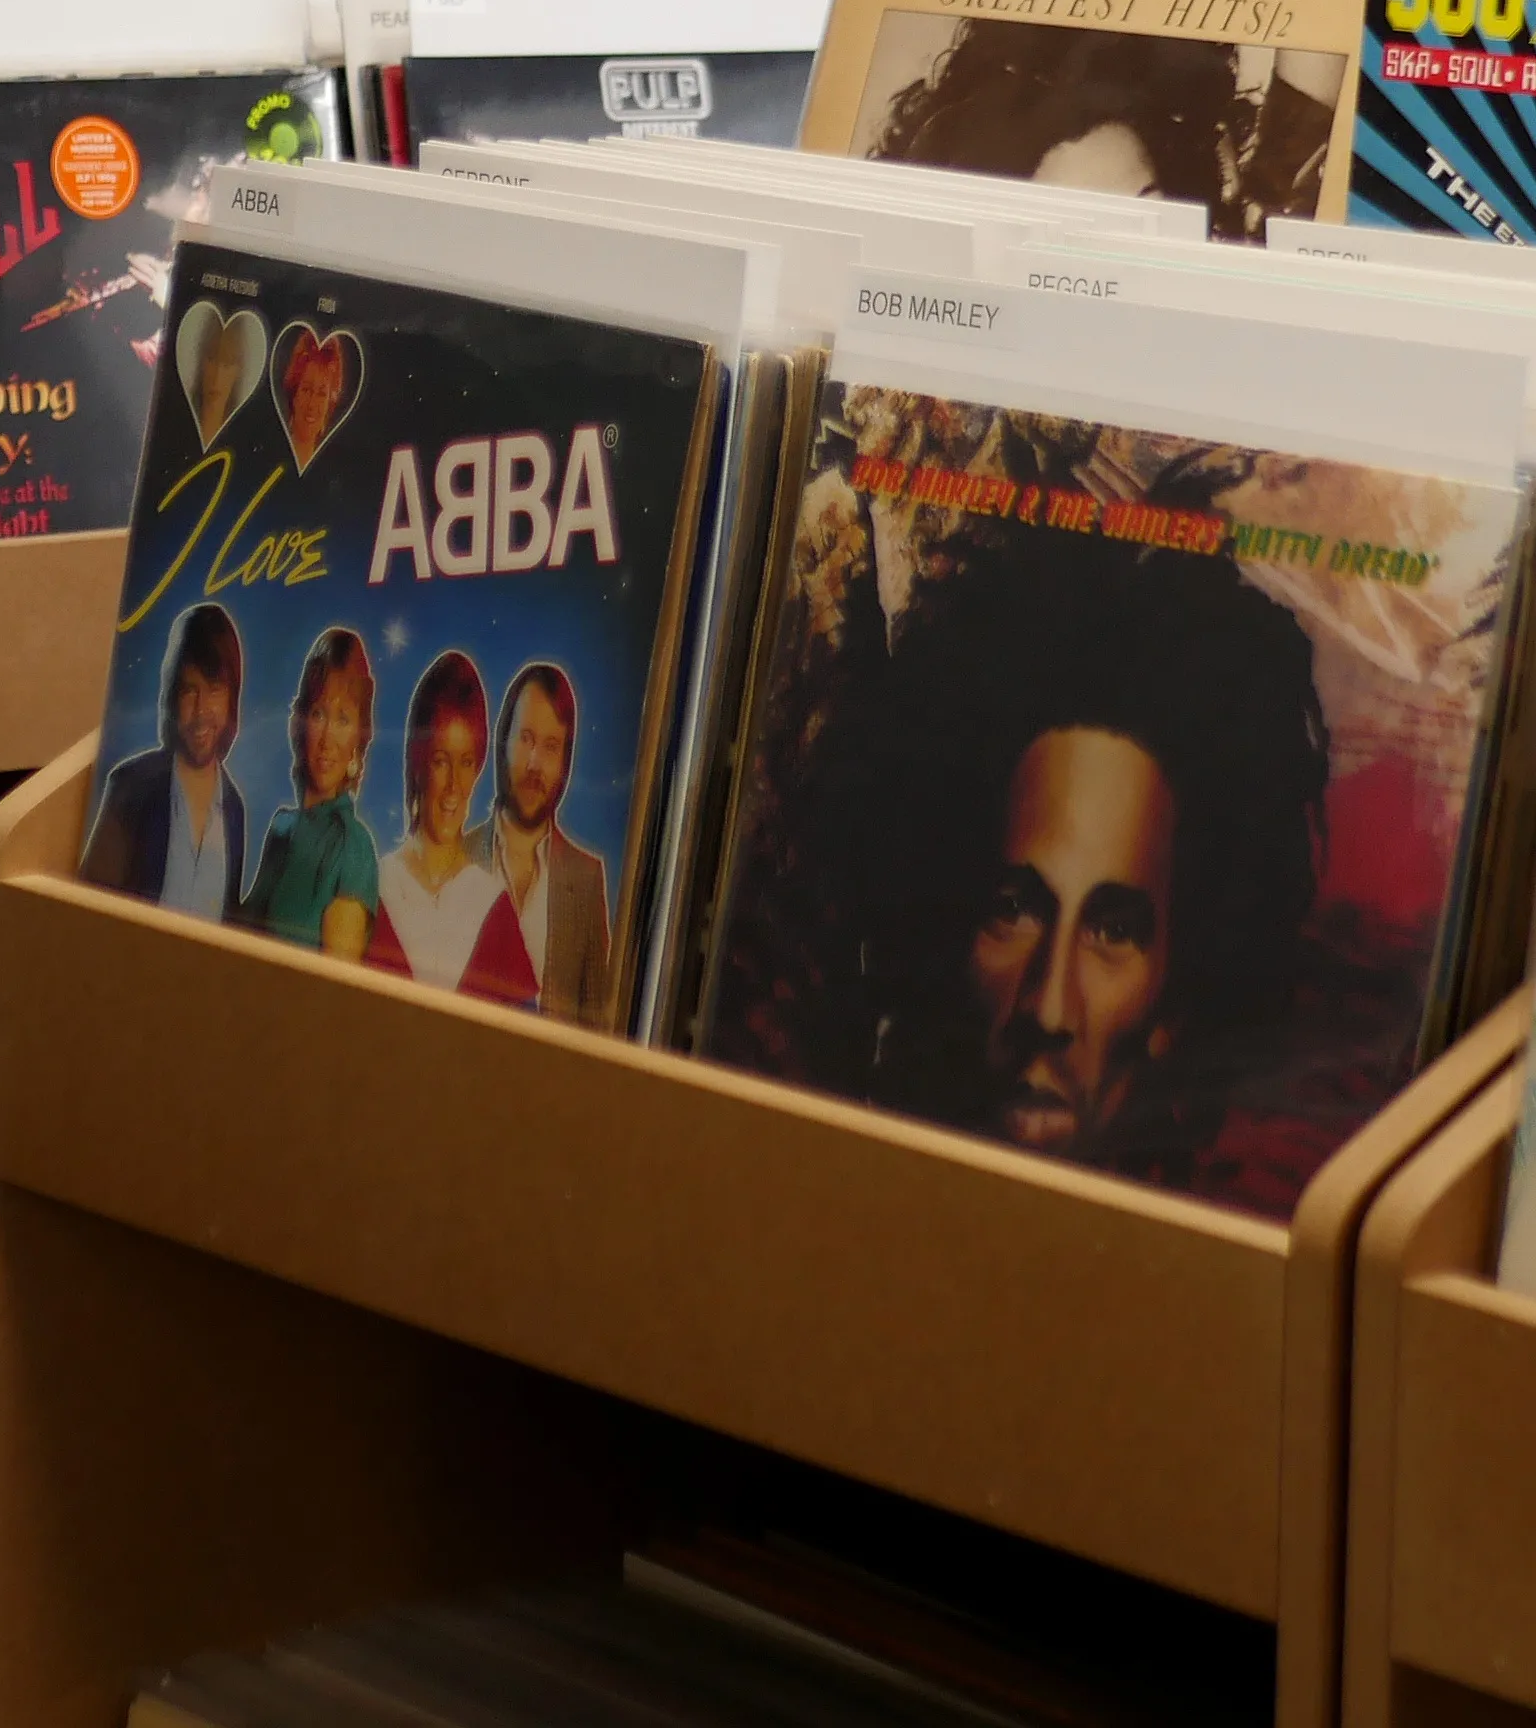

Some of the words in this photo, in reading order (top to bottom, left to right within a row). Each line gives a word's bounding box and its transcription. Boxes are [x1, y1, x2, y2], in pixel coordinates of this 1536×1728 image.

[610, 71, 701, 111] PULP
[231, 187, 281, 217] ABBA
[1425, 146, 1498, 229] THE
[857, 288, 903, 319] BOB
[907, 294, 1000, 332] MARLEY
[14, 479, 36, 505] at
[367, 422, 619, 588] ABBA
[850, 453, 906, 497] BOB
[909, 465, 1017, 518] MARLEY
[1046, 487, 1099, 535] THE
[1100, 500, 1226, 558] WAILERS
